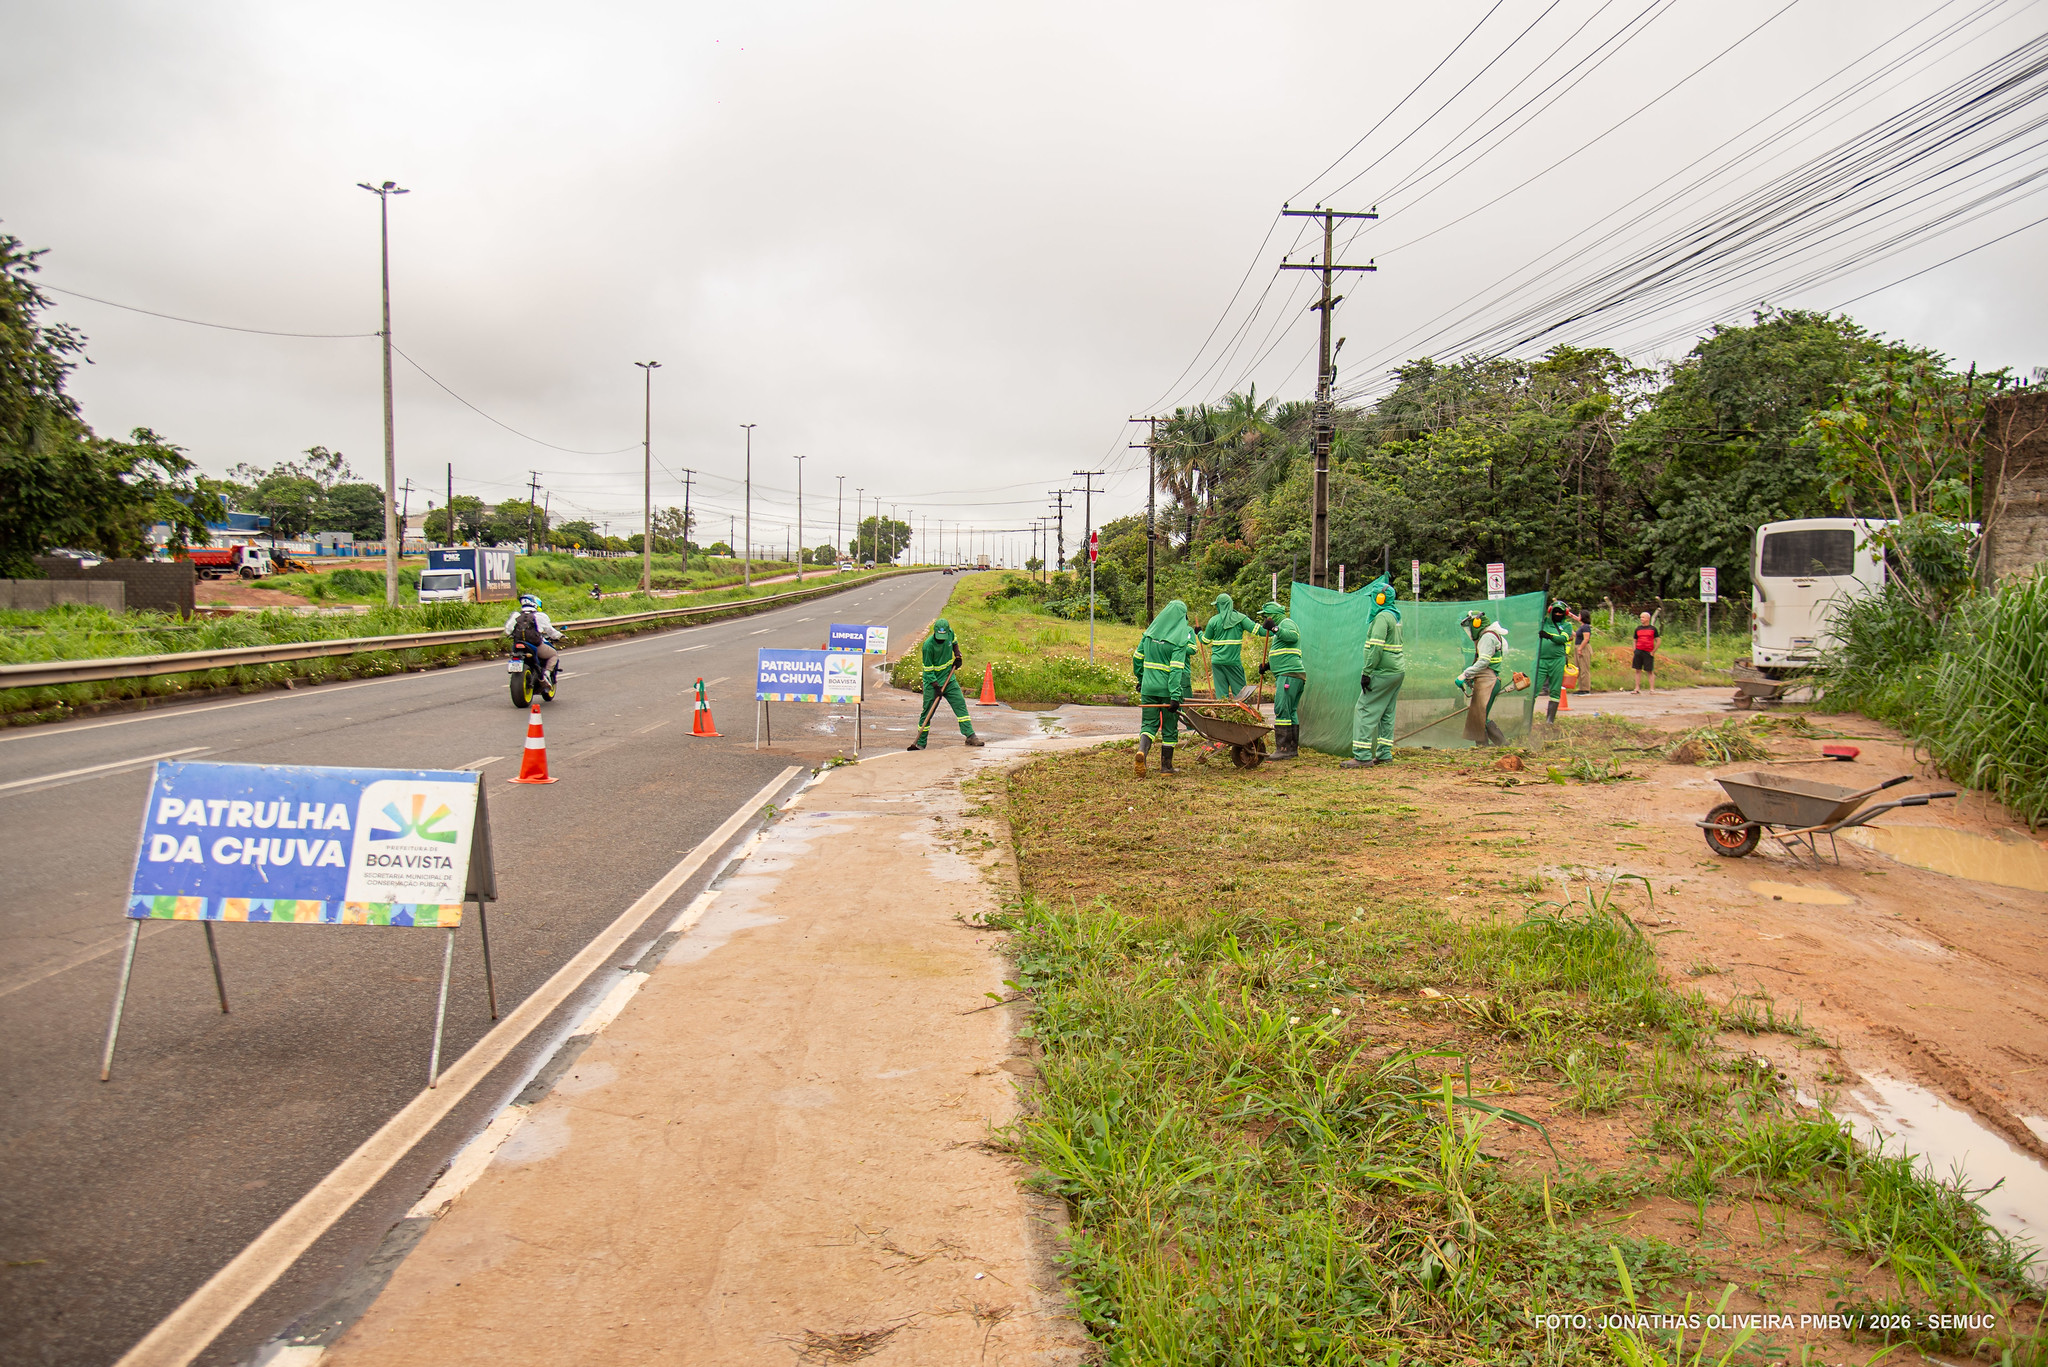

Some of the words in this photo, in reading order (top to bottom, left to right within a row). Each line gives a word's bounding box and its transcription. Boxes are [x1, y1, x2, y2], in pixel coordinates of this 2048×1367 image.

[486, 552, 510, 580] PMZ
[832, 632, 864, 640] LIMPEZA
[761, 661, 823, 672] PATRULHA
[760, 673, 778, 683] DA
[779, 673, 822, 684] CHUVA
[156, 797, 351, 831] PATRULHA
[149, 833, 204, 864] DA
[211, 836, 347, 868] CHUVA
[366, 854, 402, 868] BOA
[405, 855, 453, 869] VISTA
[366, 879, 418, 887] CONSERVAÇÃO
[419, 880, 449, 888] PÚBLICA
